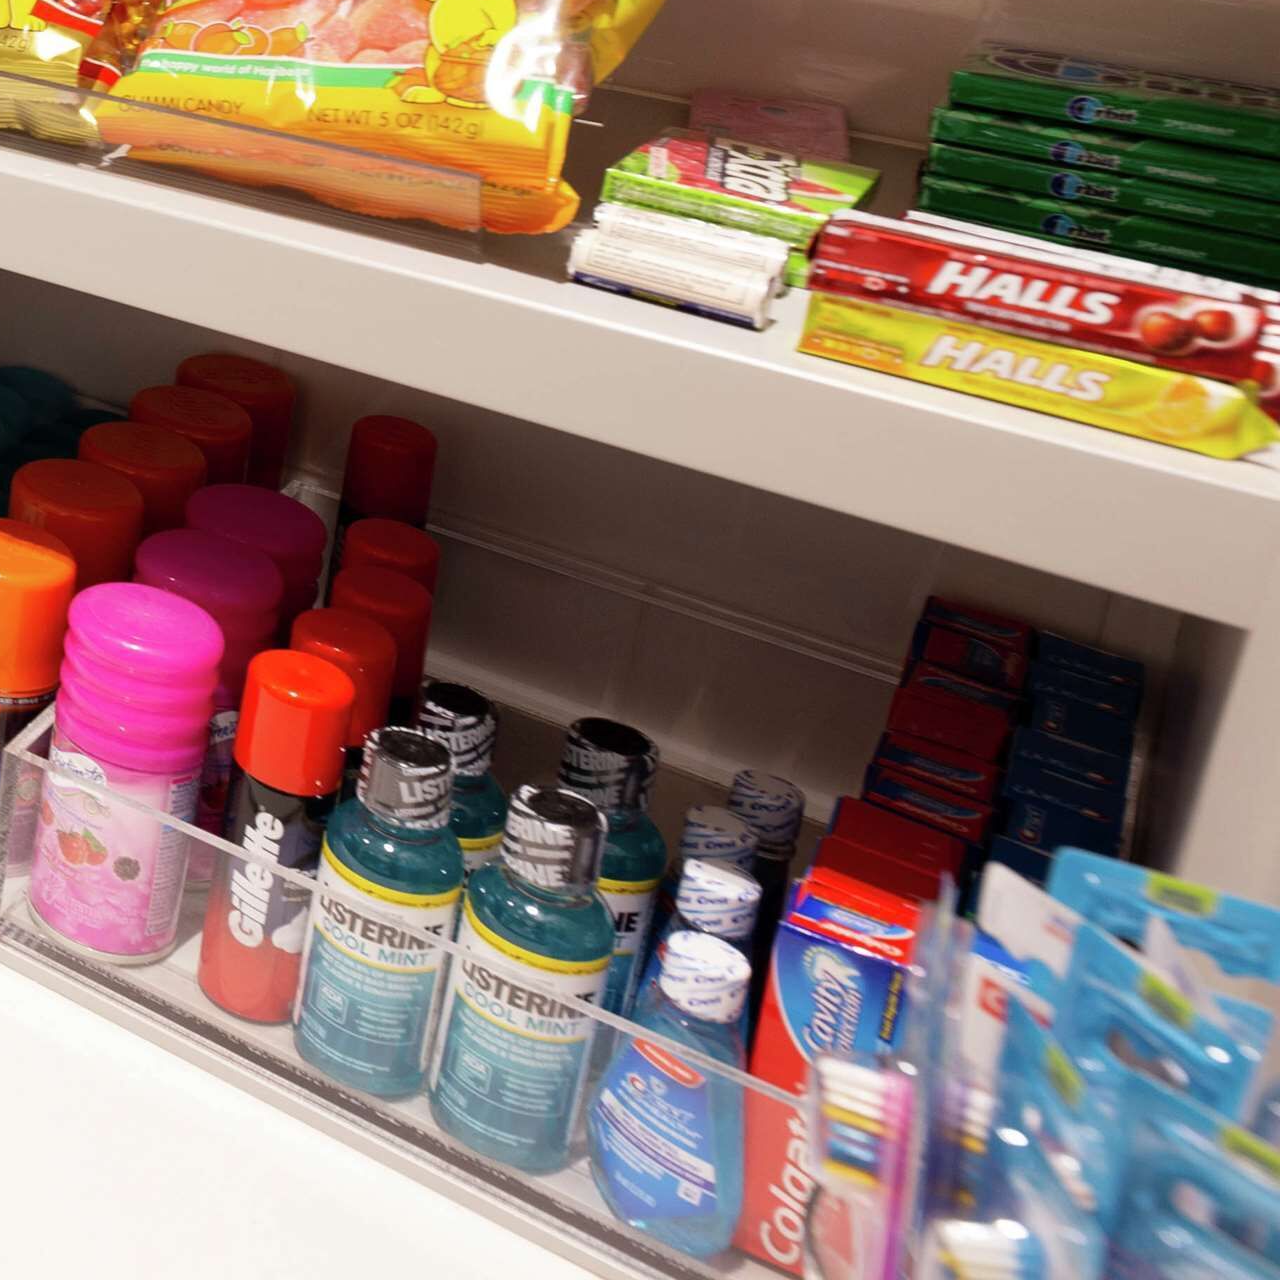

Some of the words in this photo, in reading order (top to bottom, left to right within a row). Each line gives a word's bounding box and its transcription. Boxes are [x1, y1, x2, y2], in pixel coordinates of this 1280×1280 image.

[308, 108, 341, 123] NET
[379, 111, 389, 127] 5
[394, 112, 423, 128] OZ
[926, 260, 1122, 326] HALLS
[921, 334, 1112, 403] HALLS
[378, 948, 431, 967] MINT
[526, 1017, 580, 1036] MINT
[759, 1100, 818, 1266] Colgat
